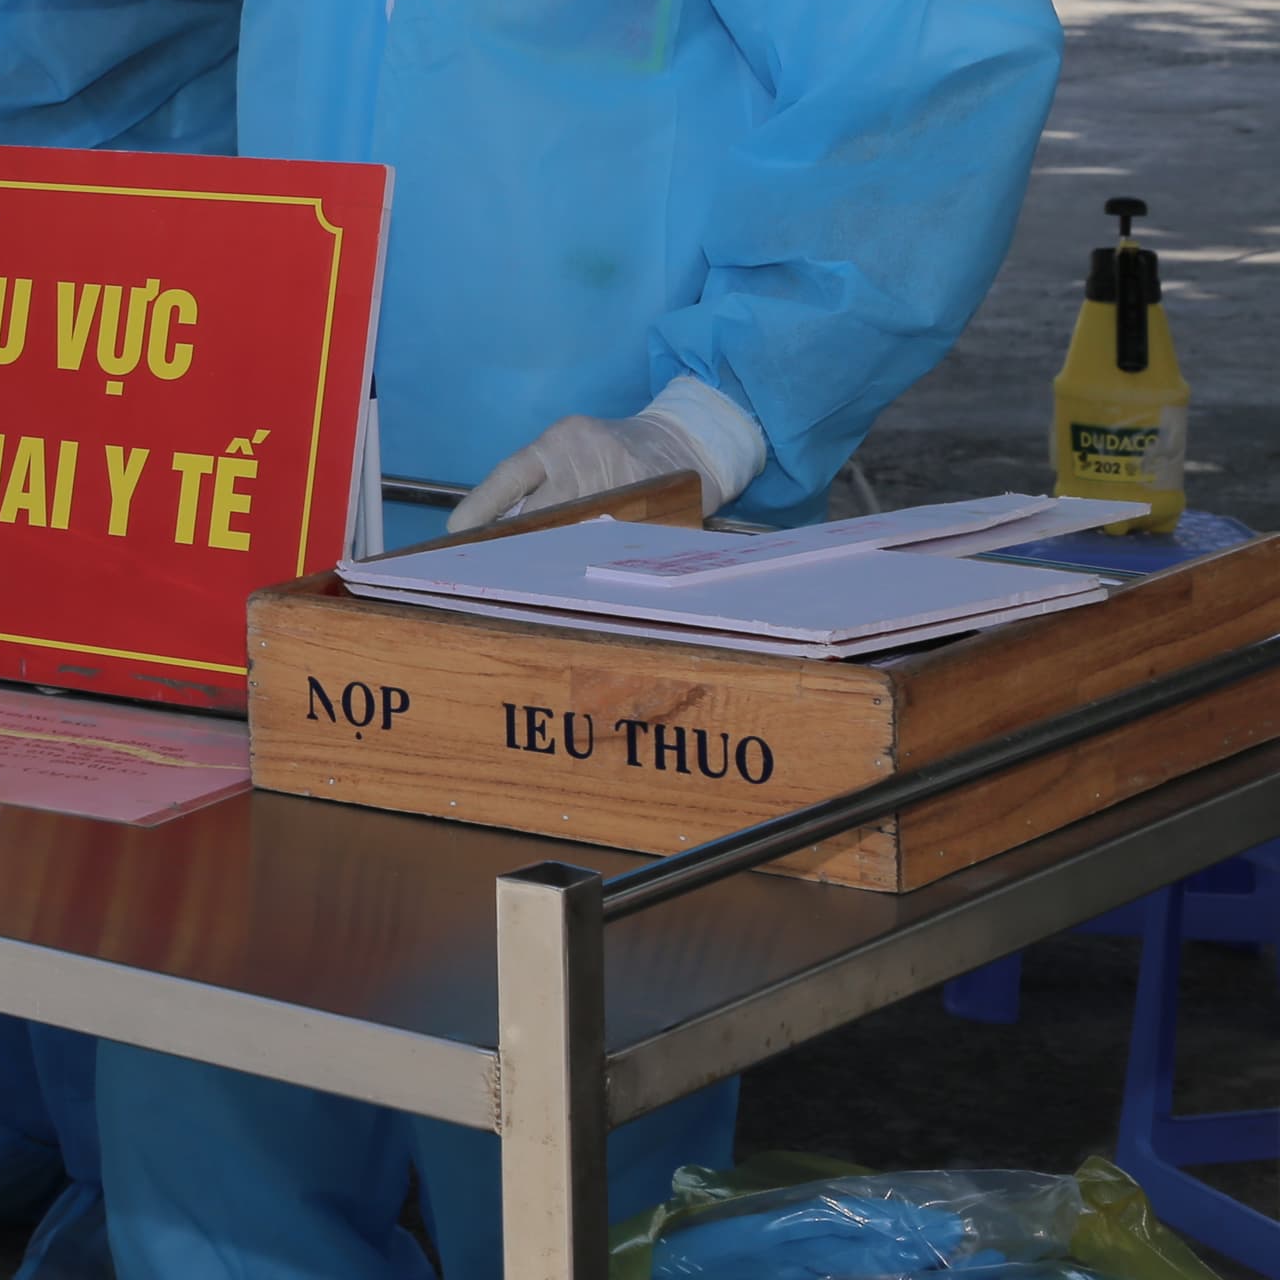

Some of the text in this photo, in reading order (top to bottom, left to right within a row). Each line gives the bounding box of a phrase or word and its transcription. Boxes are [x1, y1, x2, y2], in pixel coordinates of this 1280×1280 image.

[56, 278, 198, 396] VỰC
[105, 444, 150, 537] Y
[172, 429, 271, 552] TẾ
[1094, 461, 1121, 474] 202
